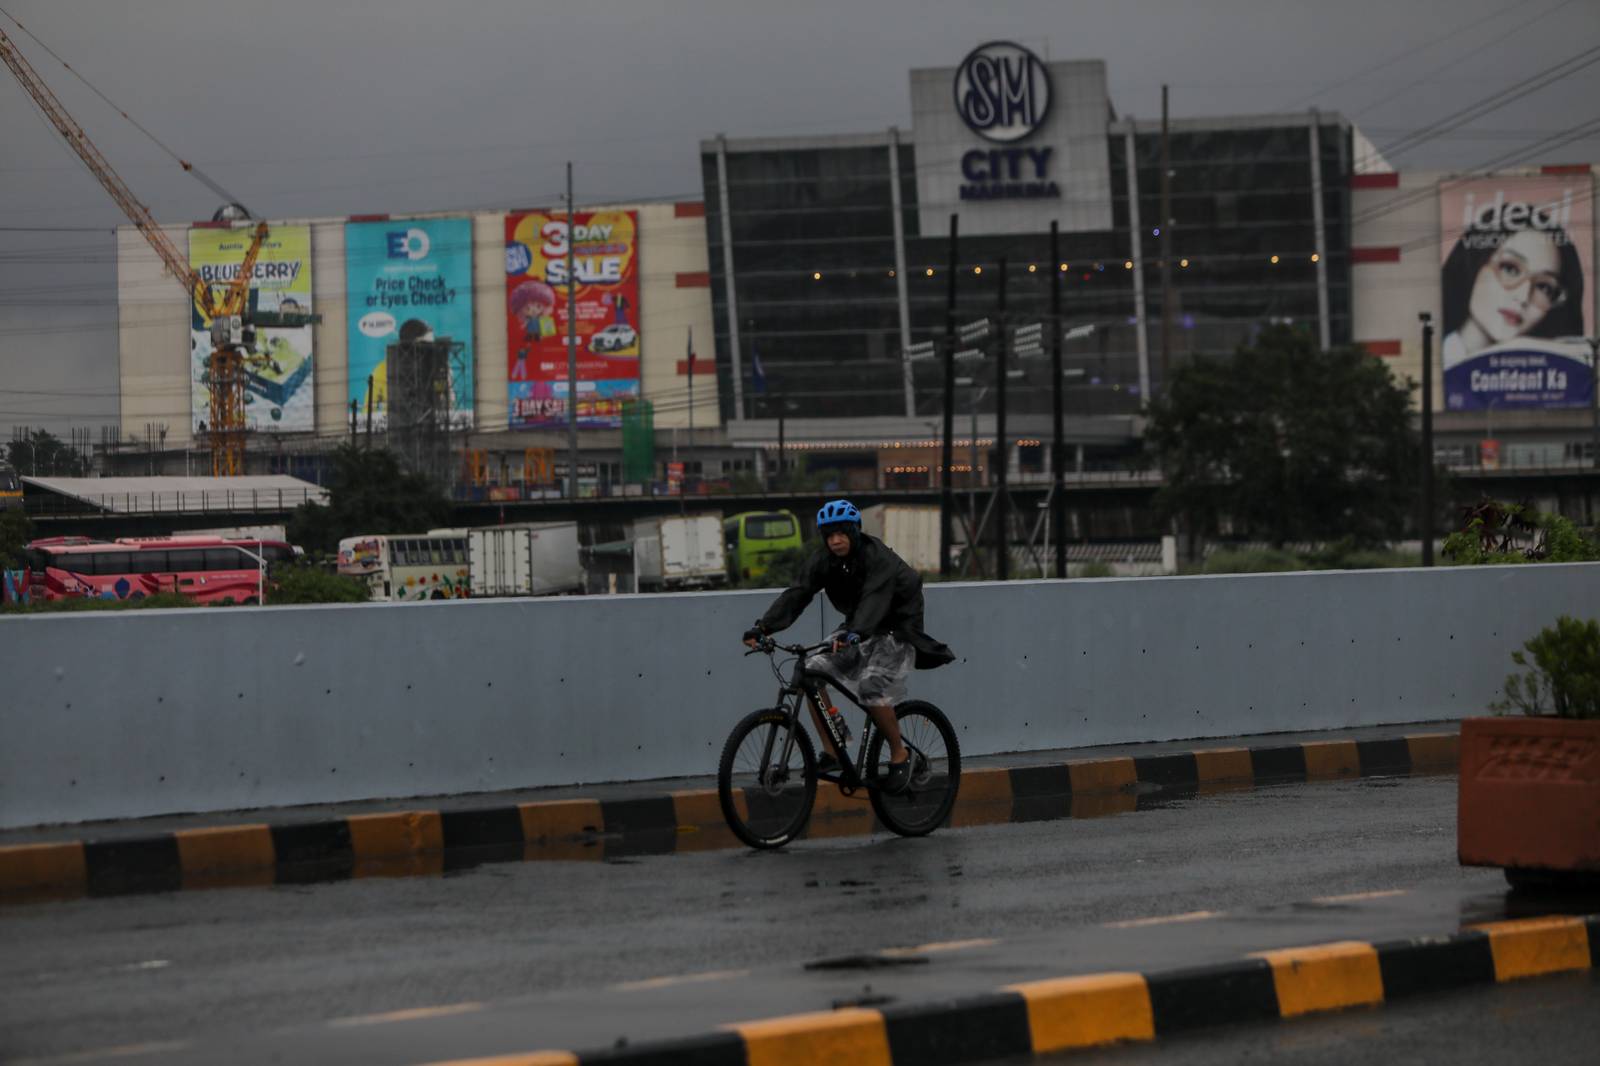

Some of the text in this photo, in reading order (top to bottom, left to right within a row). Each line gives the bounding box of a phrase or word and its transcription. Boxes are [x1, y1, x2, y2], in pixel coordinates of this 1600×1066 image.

[962, 50, 1040, 133] SM
[961, 146, 1054, 181] CITY
[1462, 189, 1572, 231] ideal
[542, 220, 613, 258] 3 DAY
[201, 261, 302, 282] BLUEERRY
[376, 276, 445, 291] Price Check
[546, 257, 622, 284] SALE
[366, 289, 456, 308] or Eyes Check?
[1471, 369, 1567, 391] Confident Ka
